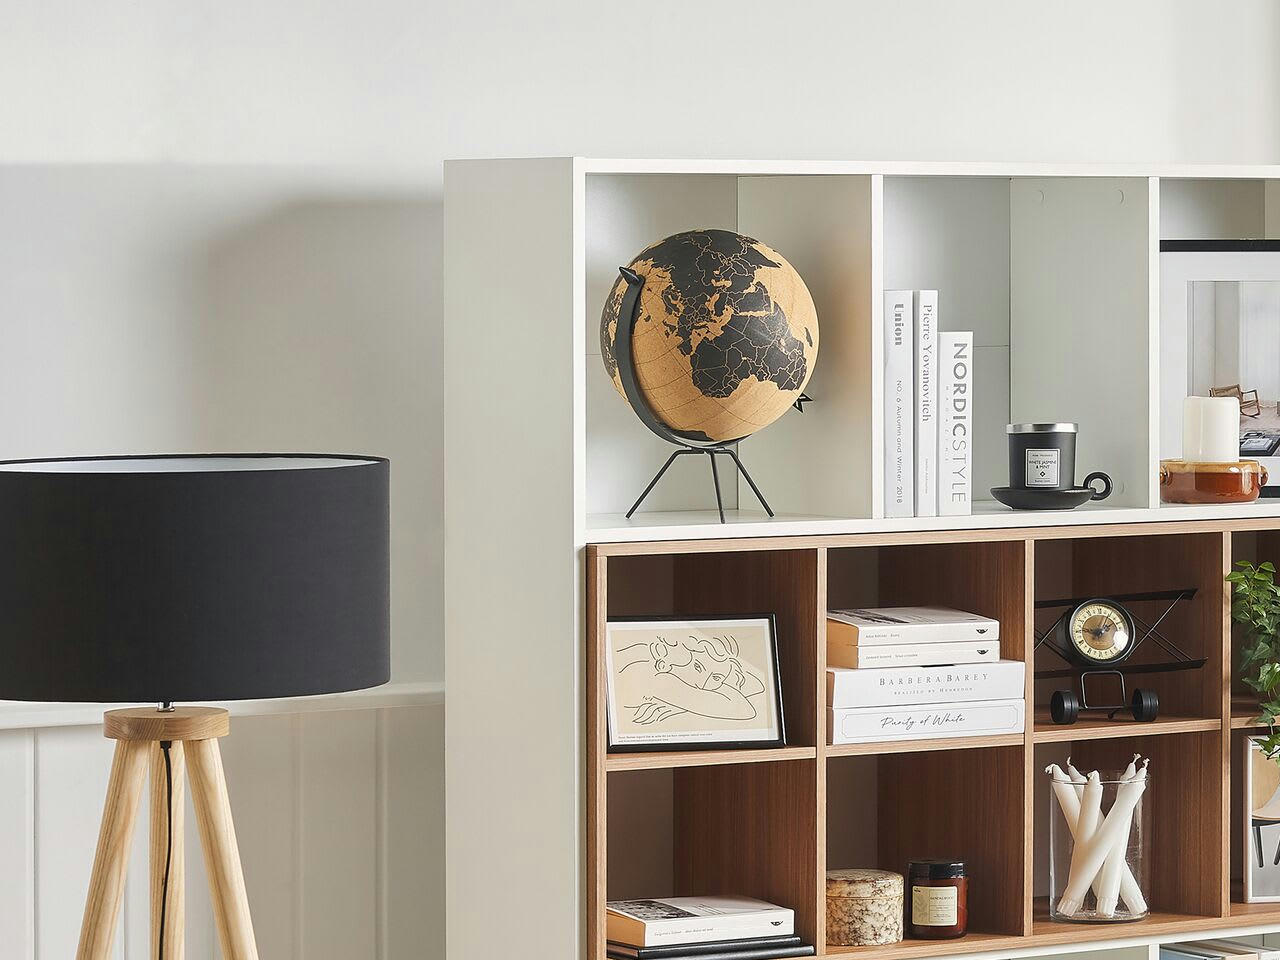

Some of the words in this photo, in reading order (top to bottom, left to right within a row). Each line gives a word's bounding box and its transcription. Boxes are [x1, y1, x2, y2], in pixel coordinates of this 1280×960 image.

[894, 303, 904, 346] Union
[922, 304, 932, 341] Pierre
[922, 344, 932, 422] Yovanovitch
[880, 716, 915, 731] Purity
[920, 714, 932, 726] of
[932, 712, 966, 726] White
